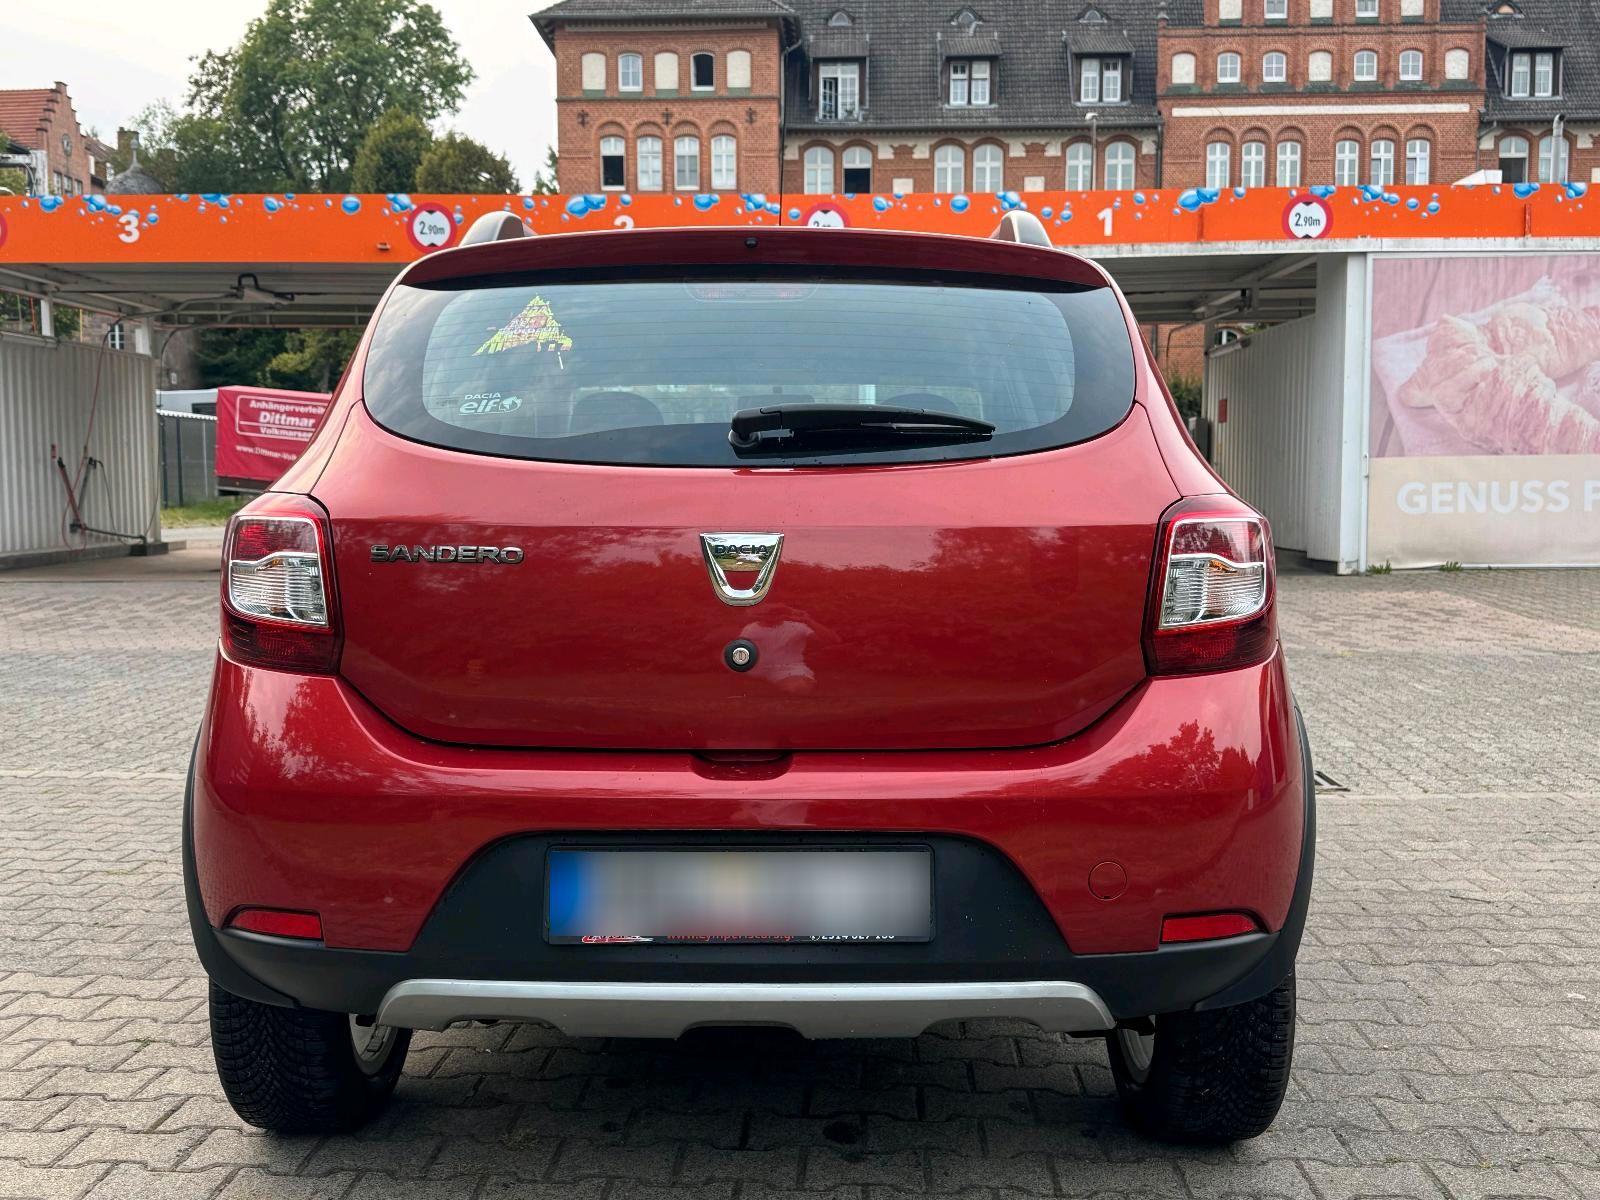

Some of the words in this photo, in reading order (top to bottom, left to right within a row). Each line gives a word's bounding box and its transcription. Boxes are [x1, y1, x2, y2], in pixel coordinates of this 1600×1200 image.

[118, 213, 140, 244] 3
[1096, 207, 1113, 237] 1
[464, 392, 502, 400] DACIA
[259, 411, 316, 428] Dittmar
[1395, 479, 1571, 516] GENUSS
[370, 544, 525, 564] SANDERO
[714, 544, 770, 555] DACIA
